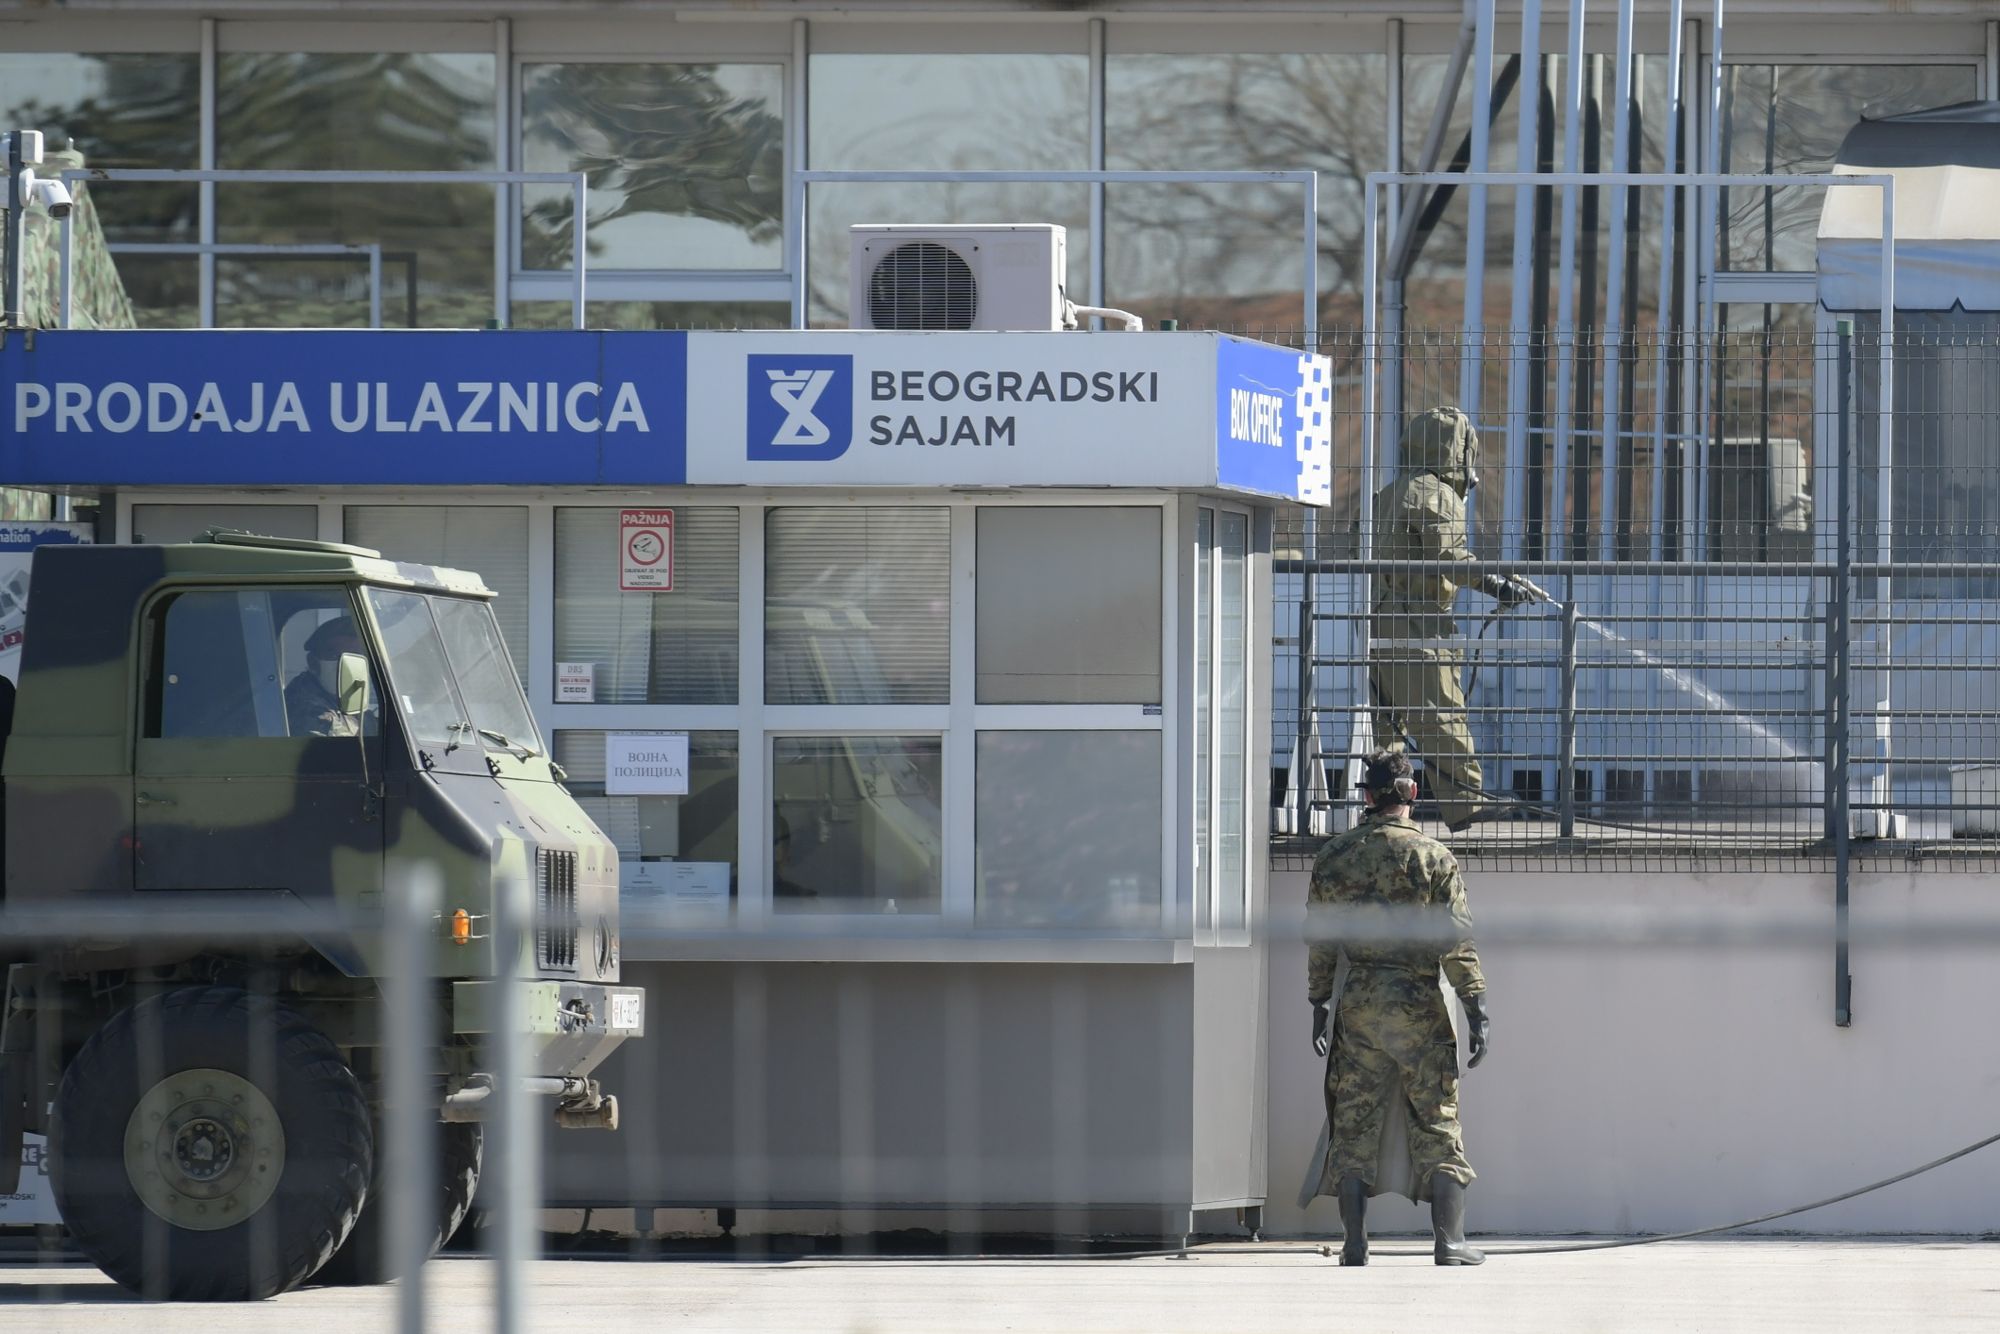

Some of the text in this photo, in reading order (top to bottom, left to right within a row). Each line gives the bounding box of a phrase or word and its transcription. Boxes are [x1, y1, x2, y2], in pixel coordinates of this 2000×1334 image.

[870, 371, 1159, 403] BEOGRADSKI
[15, 382, 649, 433] PRODAJA ULAZNICA
[1231, 388, 1282, 447] BOX OFFICE
[870, 415, 1016, 447] SAJAM
[622, 512, 669, 525] PAŽNJA
[614, 767, 683, 778] ПОЛИЦИЈА
[628, 751, 668, 763] ВОЈНА
